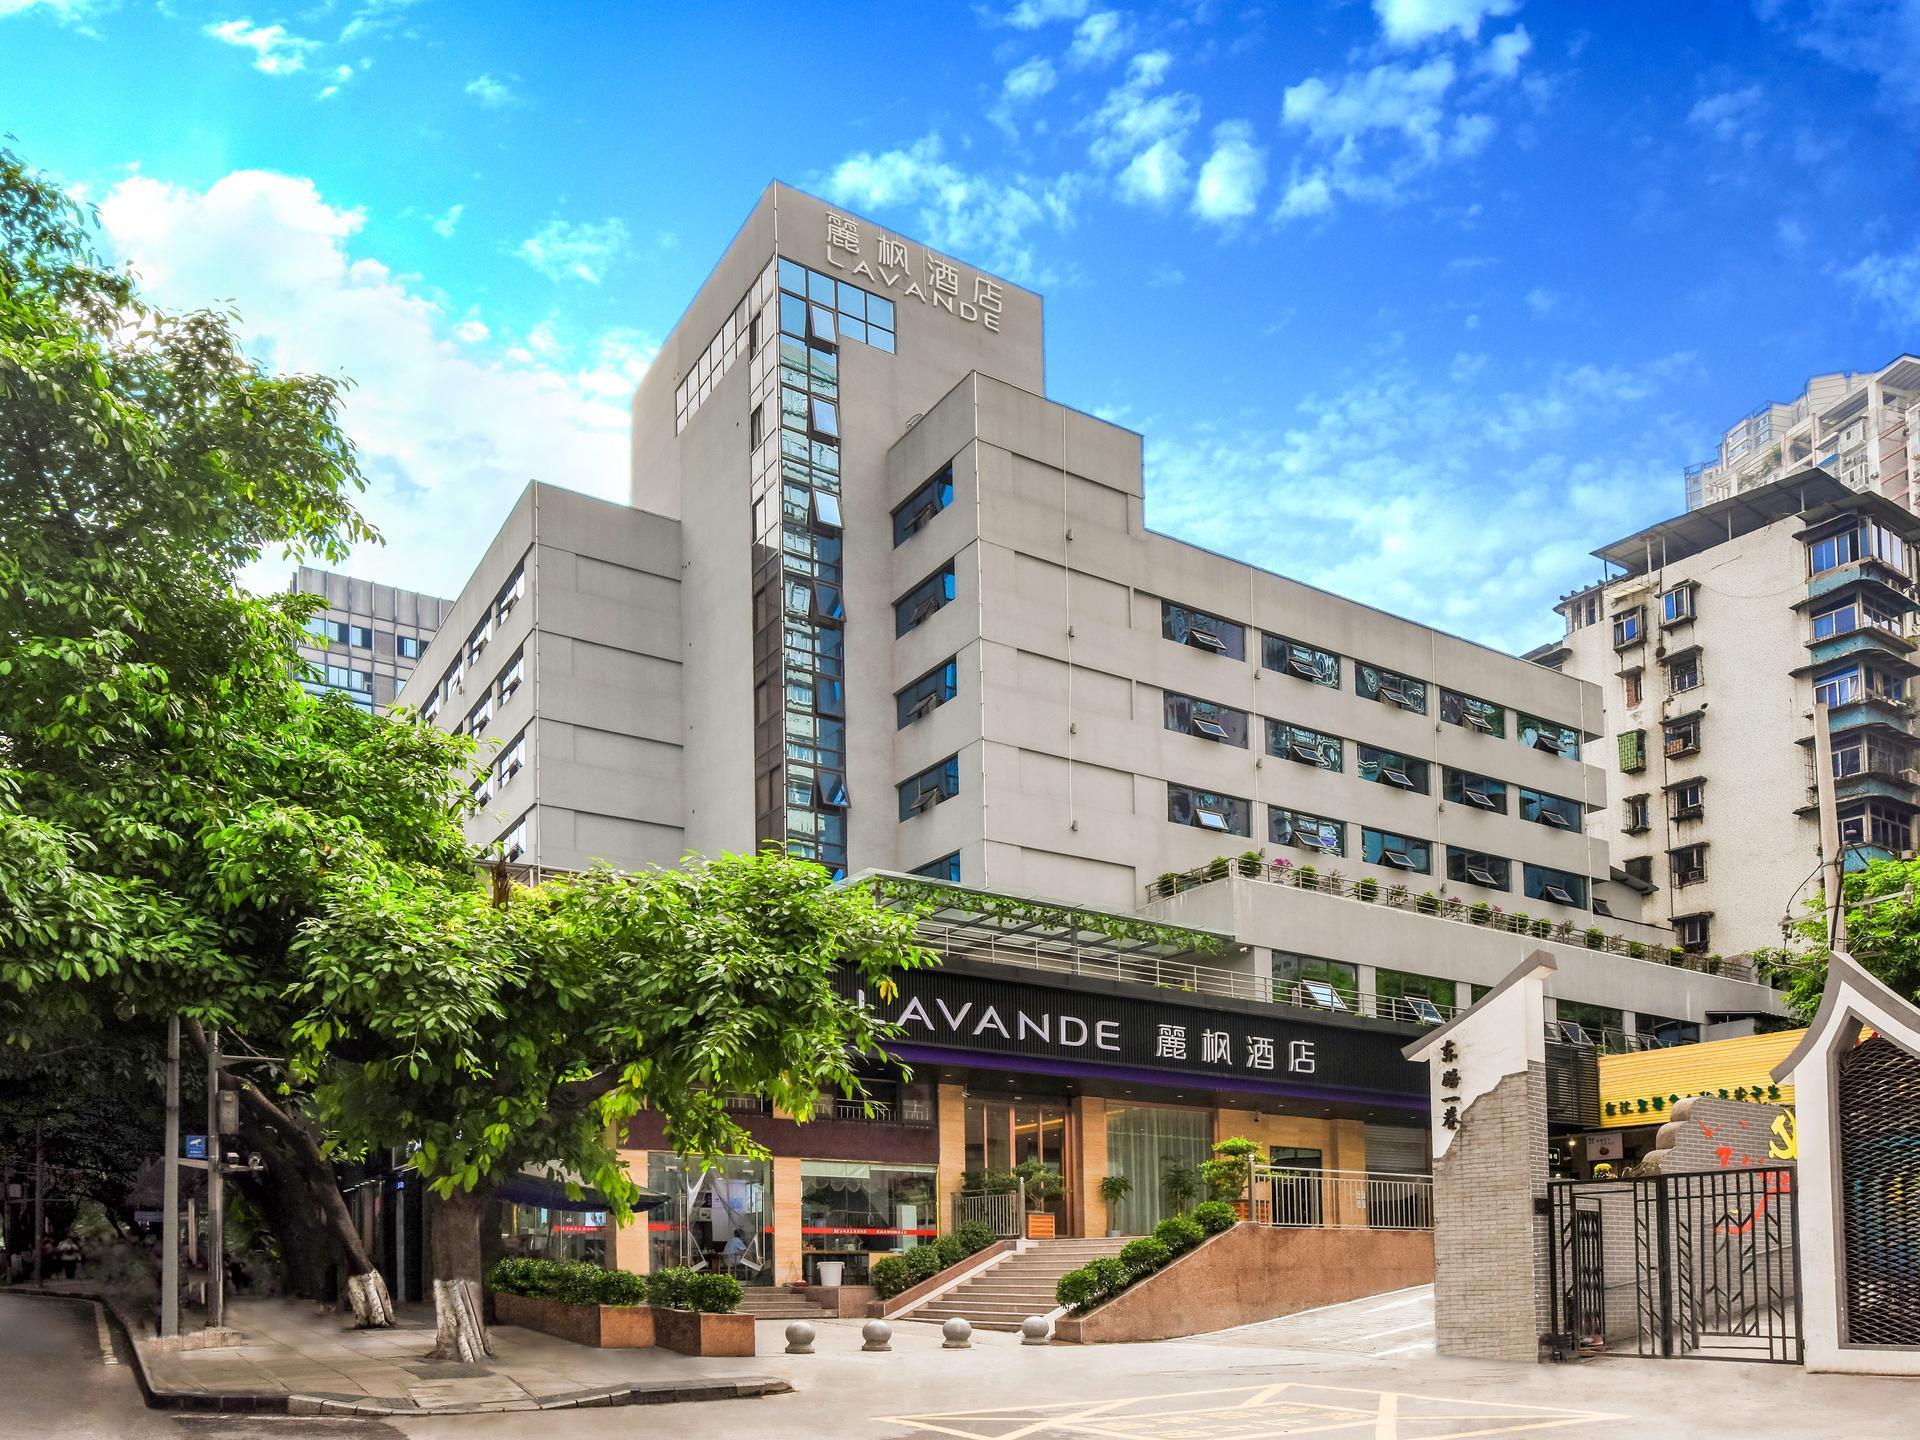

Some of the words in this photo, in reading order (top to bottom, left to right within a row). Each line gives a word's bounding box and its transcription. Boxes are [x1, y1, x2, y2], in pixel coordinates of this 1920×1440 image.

[826, 211, 1004, 313] 麗枫酒店
[827, 245, 1000, 333] LAVANDE
[858, 989, 1121, 1051] LAVANDE
[1156, 1023, 1316, 1075] 麗枫酒店
